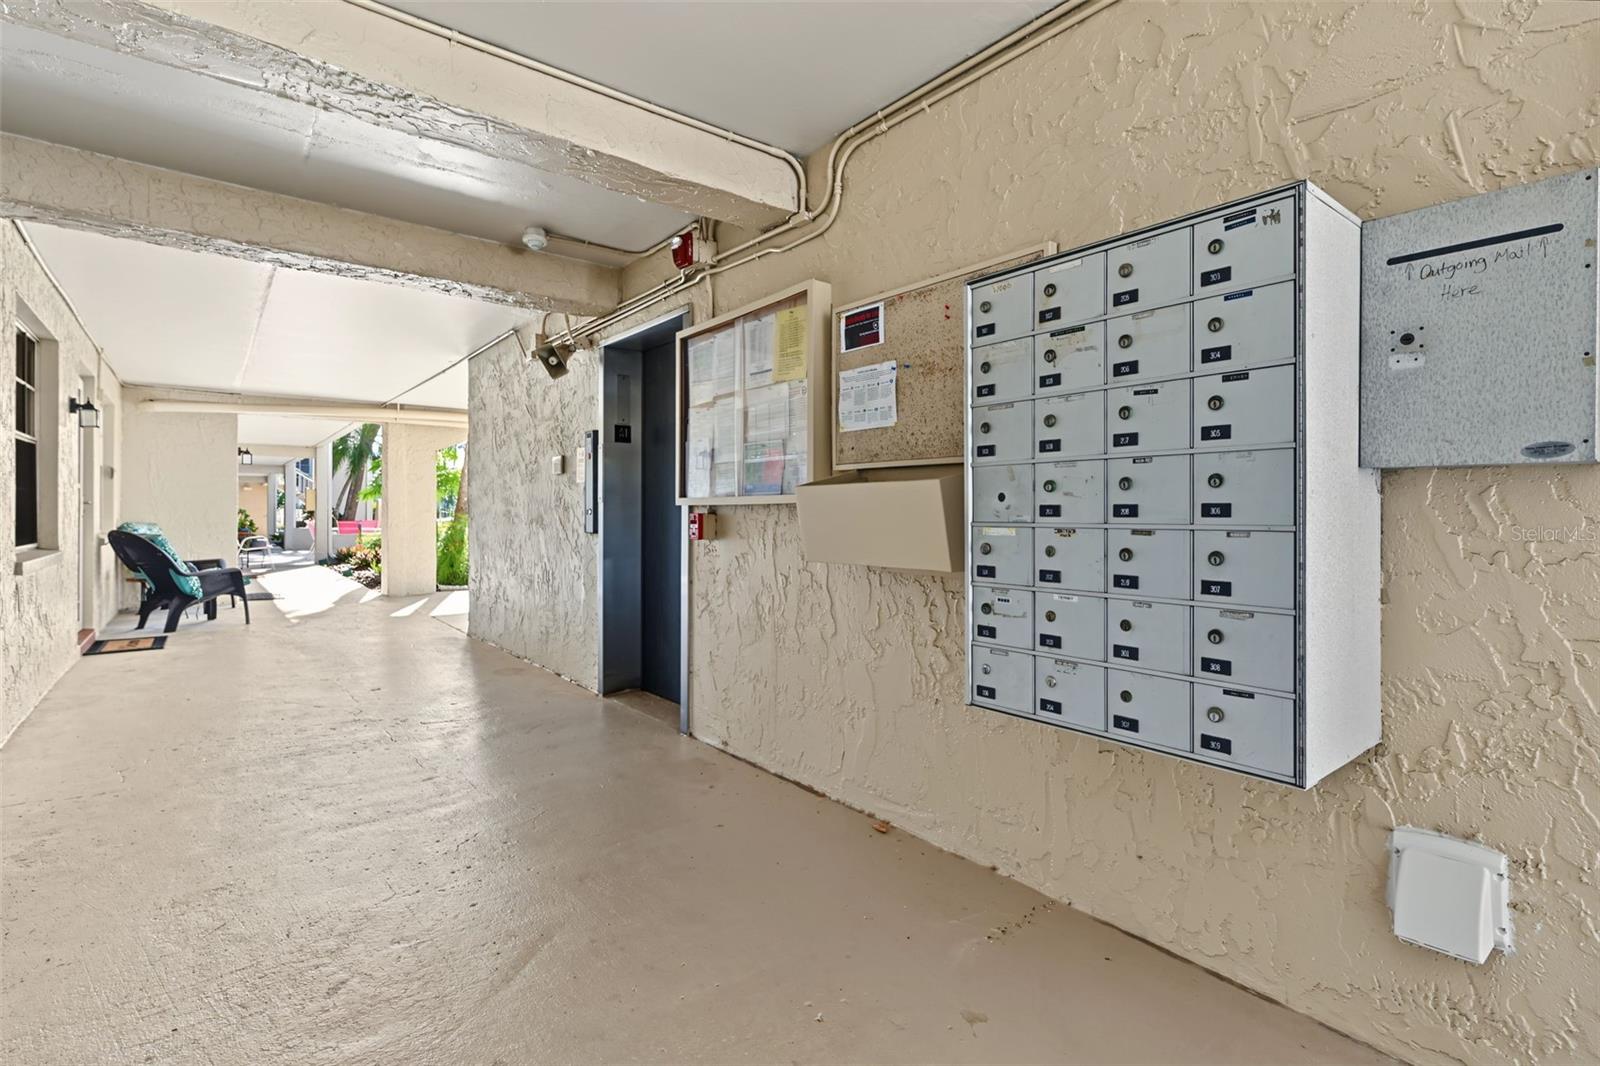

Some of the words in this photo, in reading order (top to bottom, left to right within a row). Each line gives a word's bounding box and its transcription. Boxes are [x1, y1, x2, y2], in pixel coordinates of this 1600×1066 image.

[1420, 256, 1487, 280] Outgoing
[1494, 243, 1530, 263] Mail
[1440, 284, 1480, 301] Here
